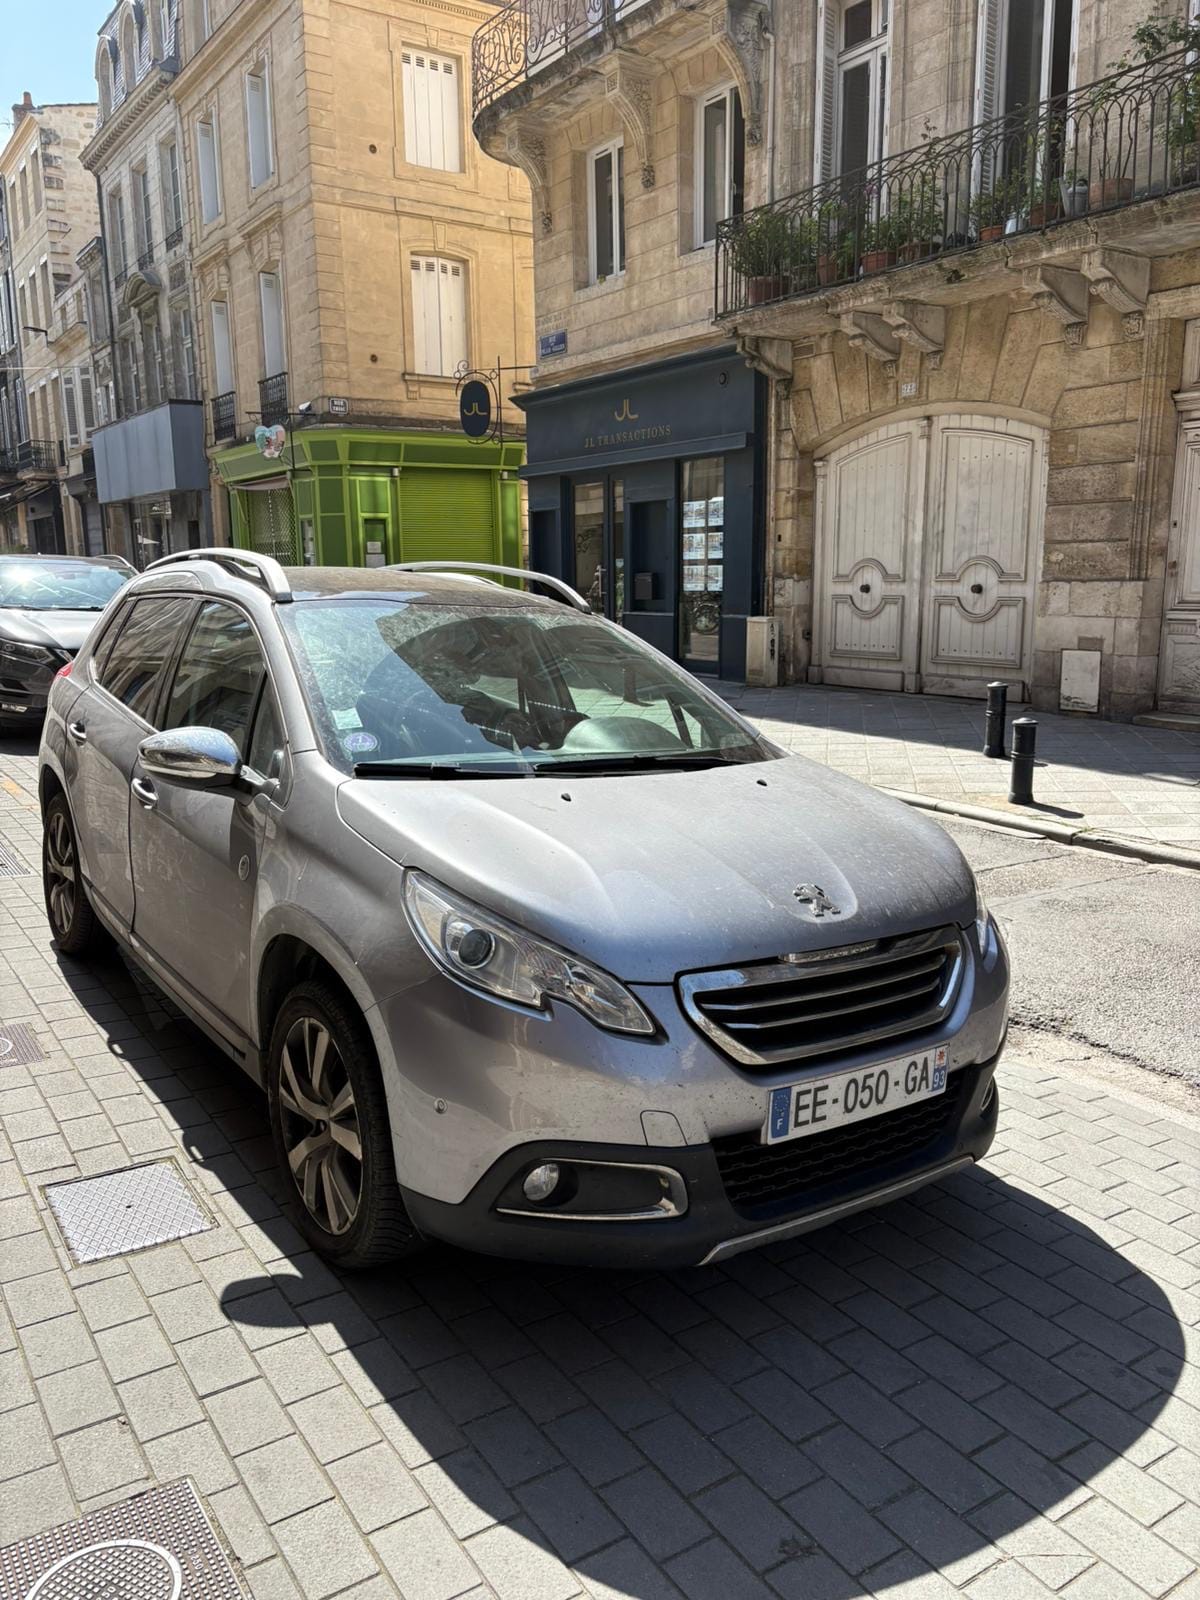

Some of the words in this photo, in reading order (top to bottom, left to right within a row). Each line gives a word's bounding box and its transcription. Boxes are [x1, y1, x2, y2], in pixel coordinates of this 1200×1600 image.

[463, 402, 487, 416] JL
[614, 399, 639, 421] JL
[584, 437, 595, 449] JL
[597, 425, 672, 447] TRANSACTIONS
[776, 1118, 784, 1130] F
[793, 1056, 930, 1129] EE-050-GA
[933, 1070, 946, 1088] 93
